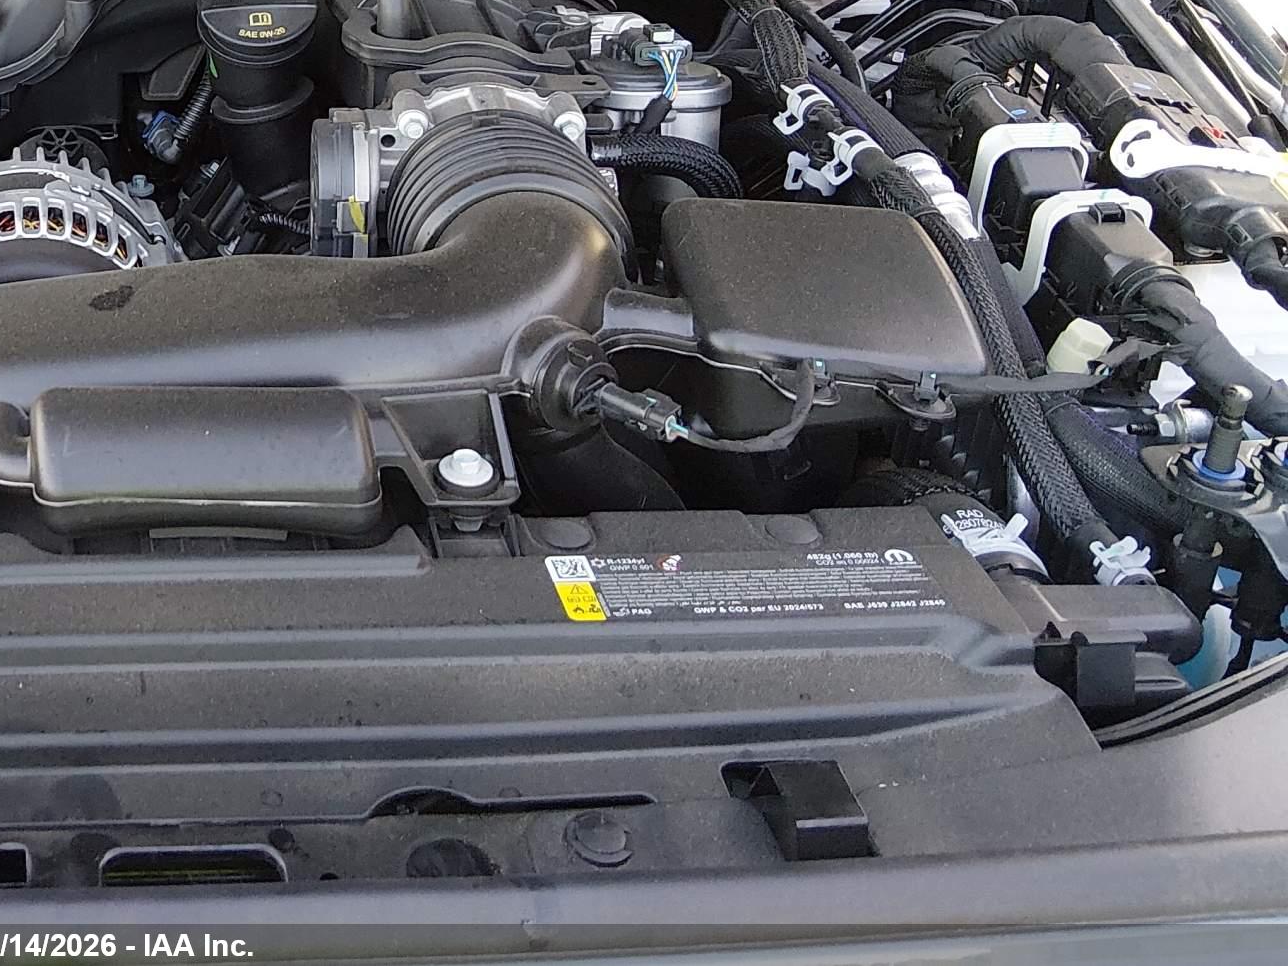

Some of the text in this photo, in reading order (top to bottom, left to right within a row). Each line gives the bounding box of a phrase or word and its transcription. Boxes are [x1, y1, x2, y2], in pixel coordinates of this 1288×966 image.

[238, 26, 287, 38] SAE 0W-20
[956, 509, 984, 519] RAD
[693, 606, 717, 614] GWP
[728, 605, 749, 613] CO2
[750, 605, 766, 613] per
[767, 604, 782, 612] EU
[844, 601, 865, 609] SAE
[631, 607, 652, 615] PAG
